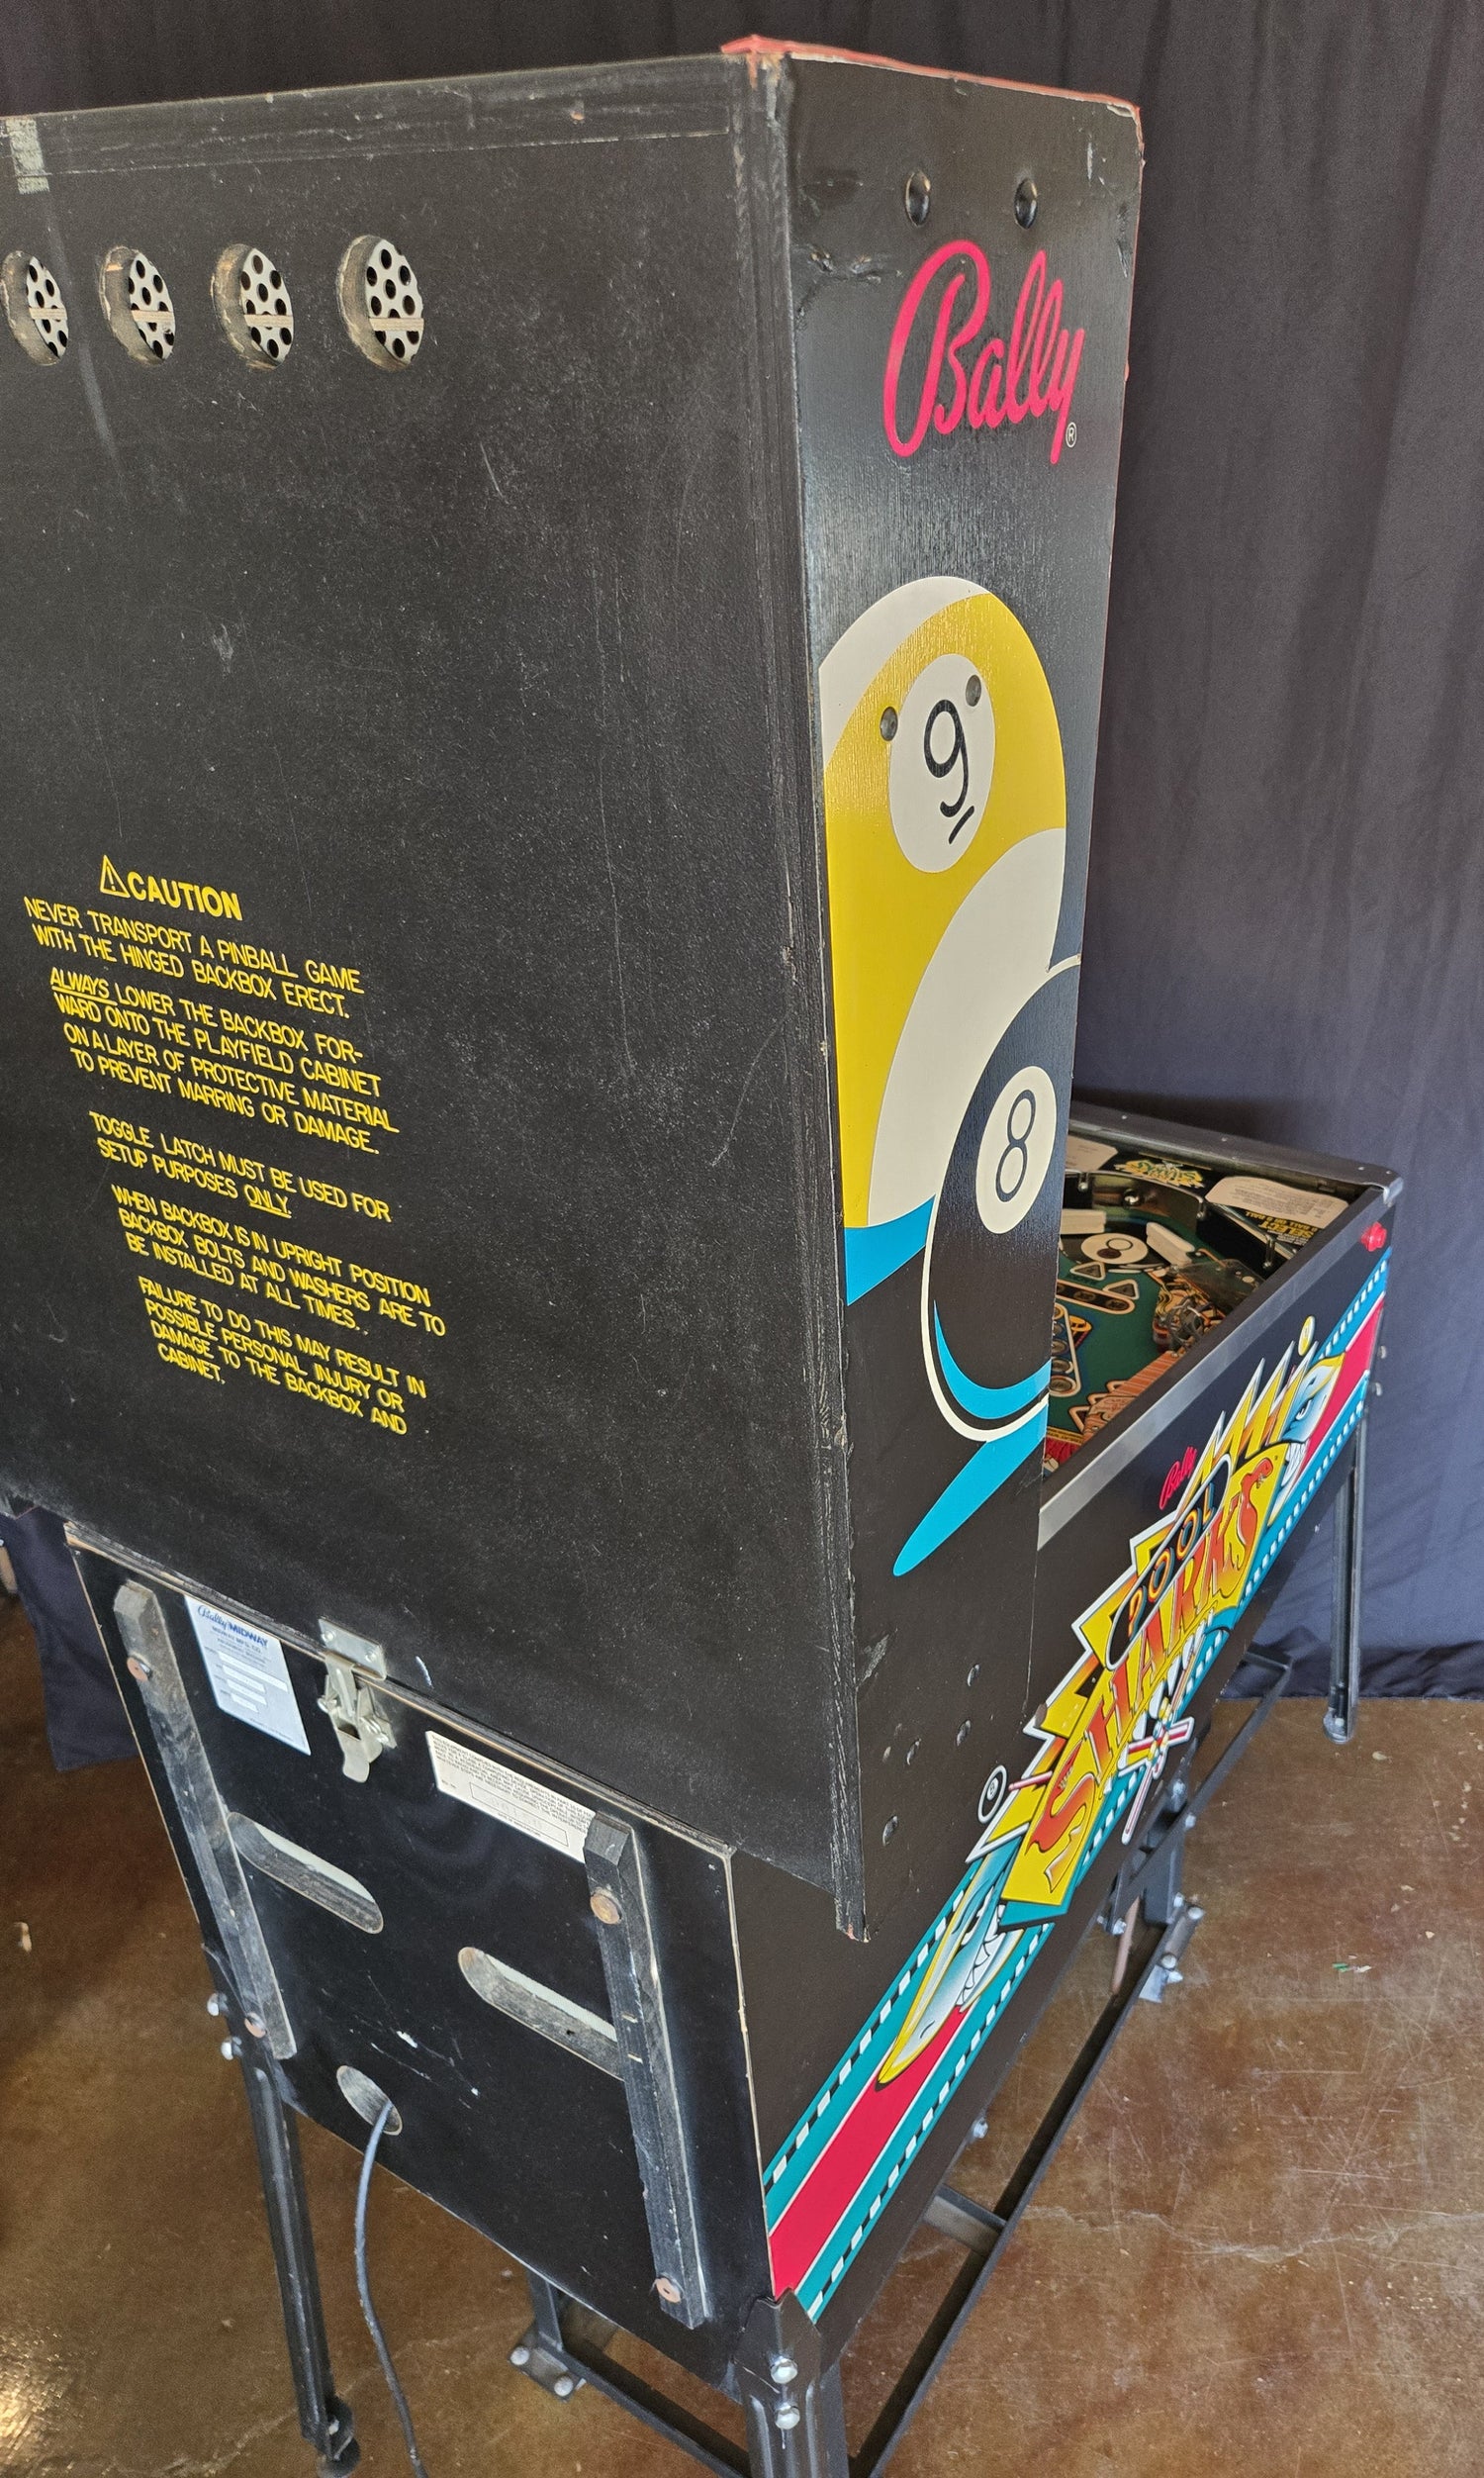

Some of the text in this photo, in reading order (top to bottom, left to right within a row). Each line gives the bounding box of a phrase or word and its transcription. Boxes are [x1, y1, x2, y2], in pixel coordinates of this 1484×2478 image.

[883, 239, 1085, 464] Bally
[923, 699, 970, 819] 9
[24, 898, 363, 994] NEVER TRANSPORT A PINBALL GAME
[127, 871, 241, 919] CAUTION
[33, 923, 349, 1018] WITH THE HINGED BACKBOX ERECT.
[49, 968, 362, 1062] ALWAYS LOWER THE BACKBOX FOR-
[53, 992, 380, 1096] WARD ONTO THE PLAYFIELD CABINET
[63, 1023, 398, 1132] ON A LAYER OF PROTECTIVE MATERIAL
[71, 1048, 379, 1154] TO PREVENT MARRING OR DAMAGE.
[994, 1089, 1037, 1203] 8
[90, 1112, 390, 1220] TOGGLE LATCH MUST BE USED FOR
[97, 1138, 290, 1218] SETUP PURPOSES ONLY.
[112, 1185, 430, 1306] WHEN BACKBOX IS IN UPRIGHT POSITION
[119, 1208, 446, 1335] BACKBOX BOLTS AND WASHERS ARE TO
[126, 1232, 146, 1255] BE
[152, 1242, 233, 1285] INSTALLED
[239, 1274, 258, 1294] AT
[265, 1283, 298, 1308] ALL
[1258, 1220, 1315, 1239] SELECT
[139, 1277, 426, 1396] FAILURE TO DO THIS MAY RESULT IN
[144, 1299, 404, 1410] POSSIBLE PERSONAL INJURY OR
[150, 1320, 407, 1434] DAMAGE TO THE BACKBOX AND
[157, 1343, 226, 1383] CABINET.
[1127, 1481, 1217, 1643] POOL
[198, 1604, 269, 1647] Bally MIDWAY
[1025, 1457, 1274, 1893] SHARKS
